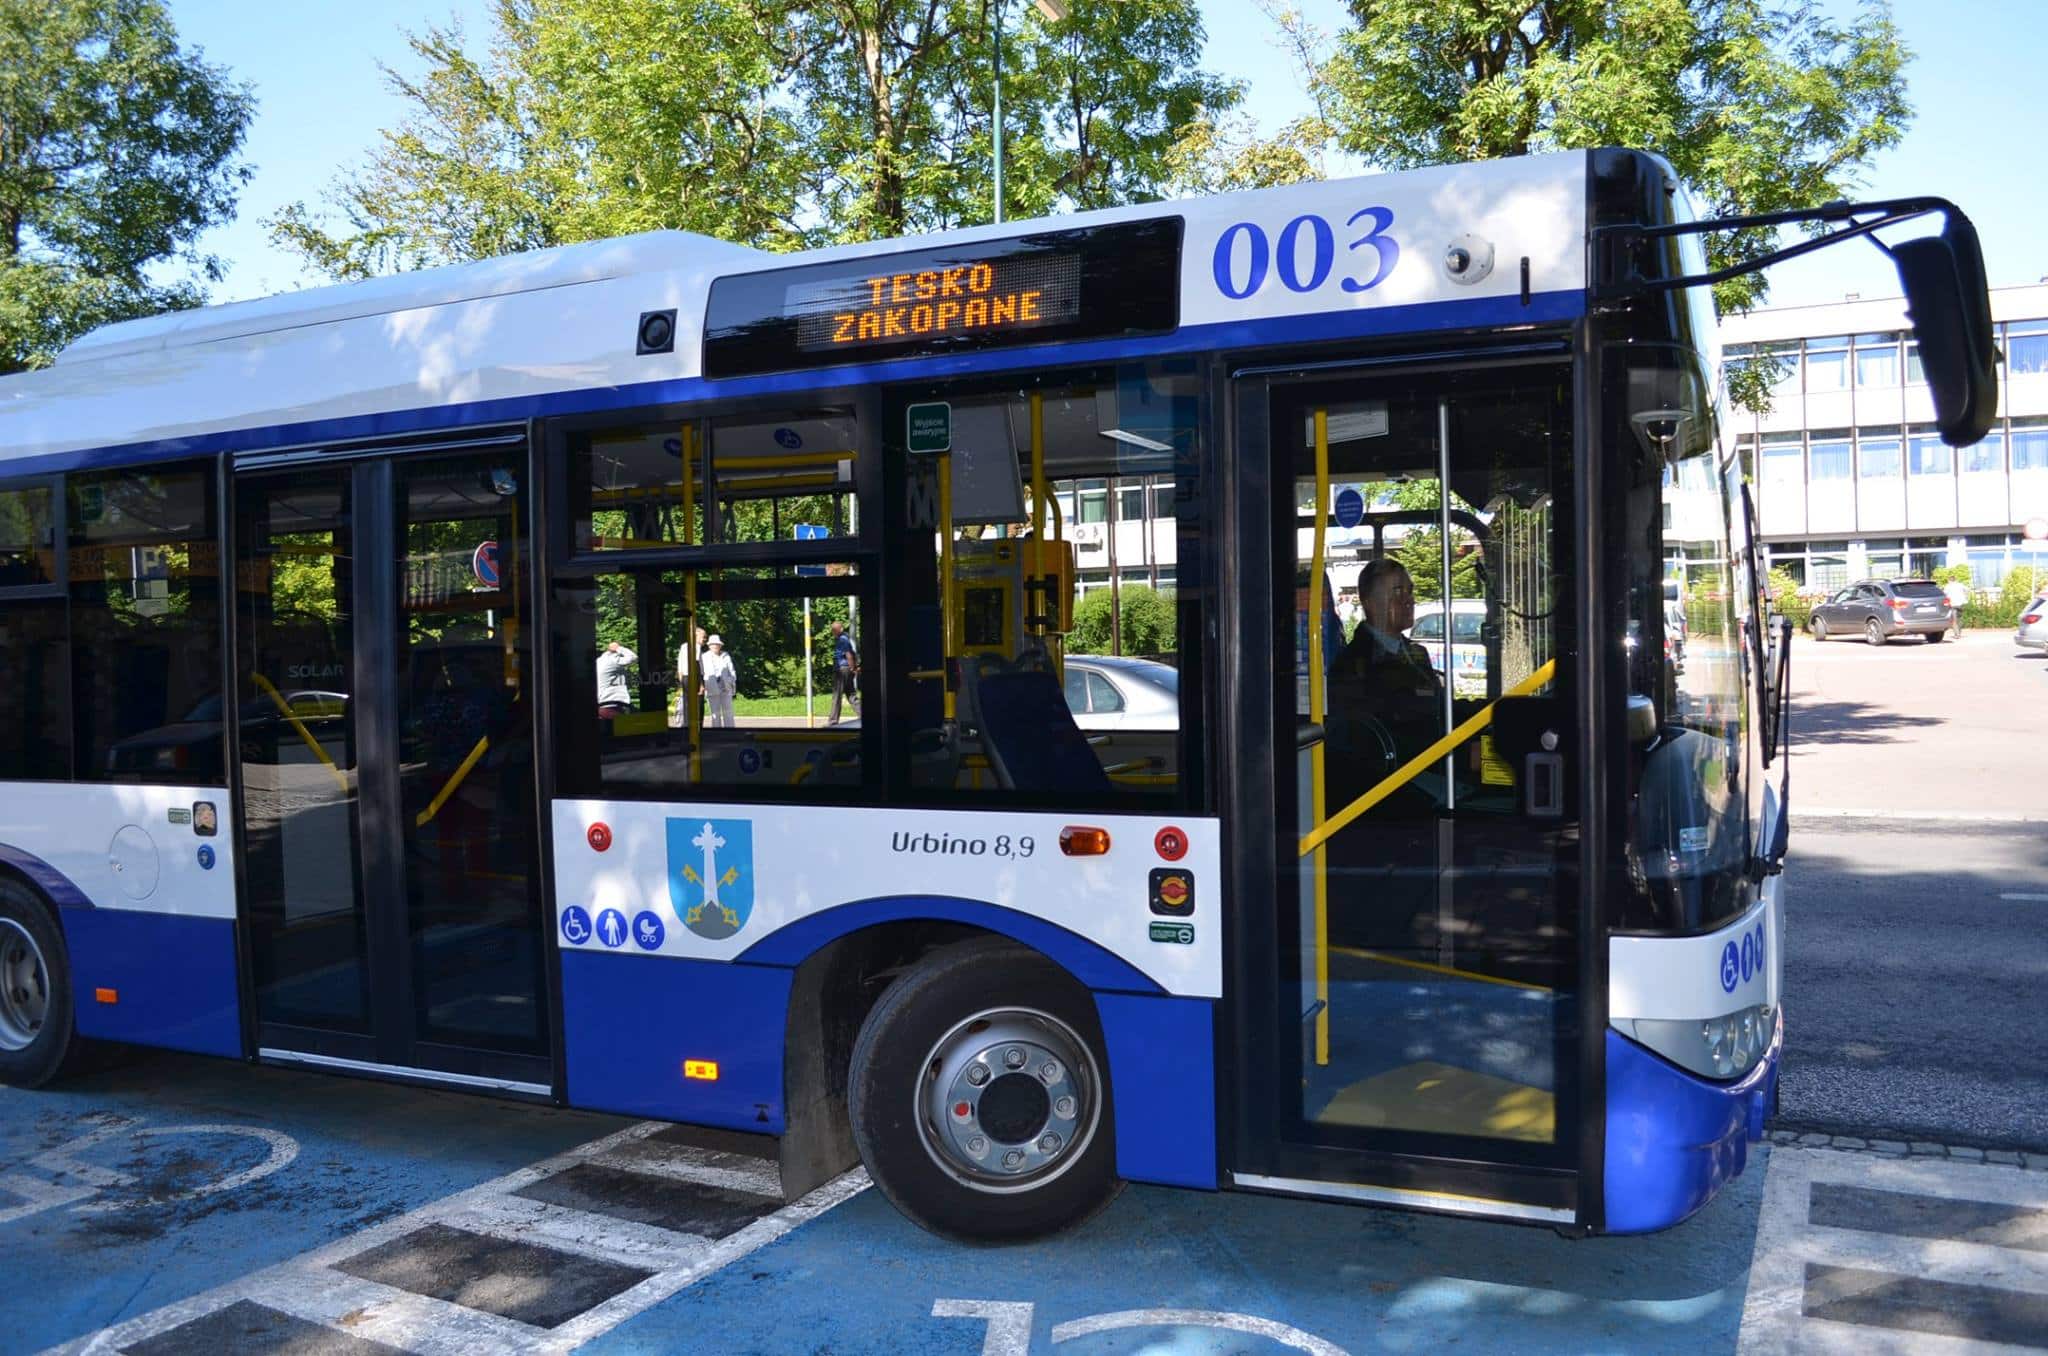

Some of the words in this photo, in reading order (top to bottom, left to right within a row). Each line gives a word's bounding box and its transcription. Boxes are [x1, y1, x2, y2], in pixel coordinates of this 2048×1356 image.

[1213, 206, 1400, 299] 003
[867, 264, 992, 306] TESKO
[833, 291, 1041, 343] ZAKOPANE
[892, 831, 987, 856] Urbino
[994, 835, 1035, 860] 8,9
